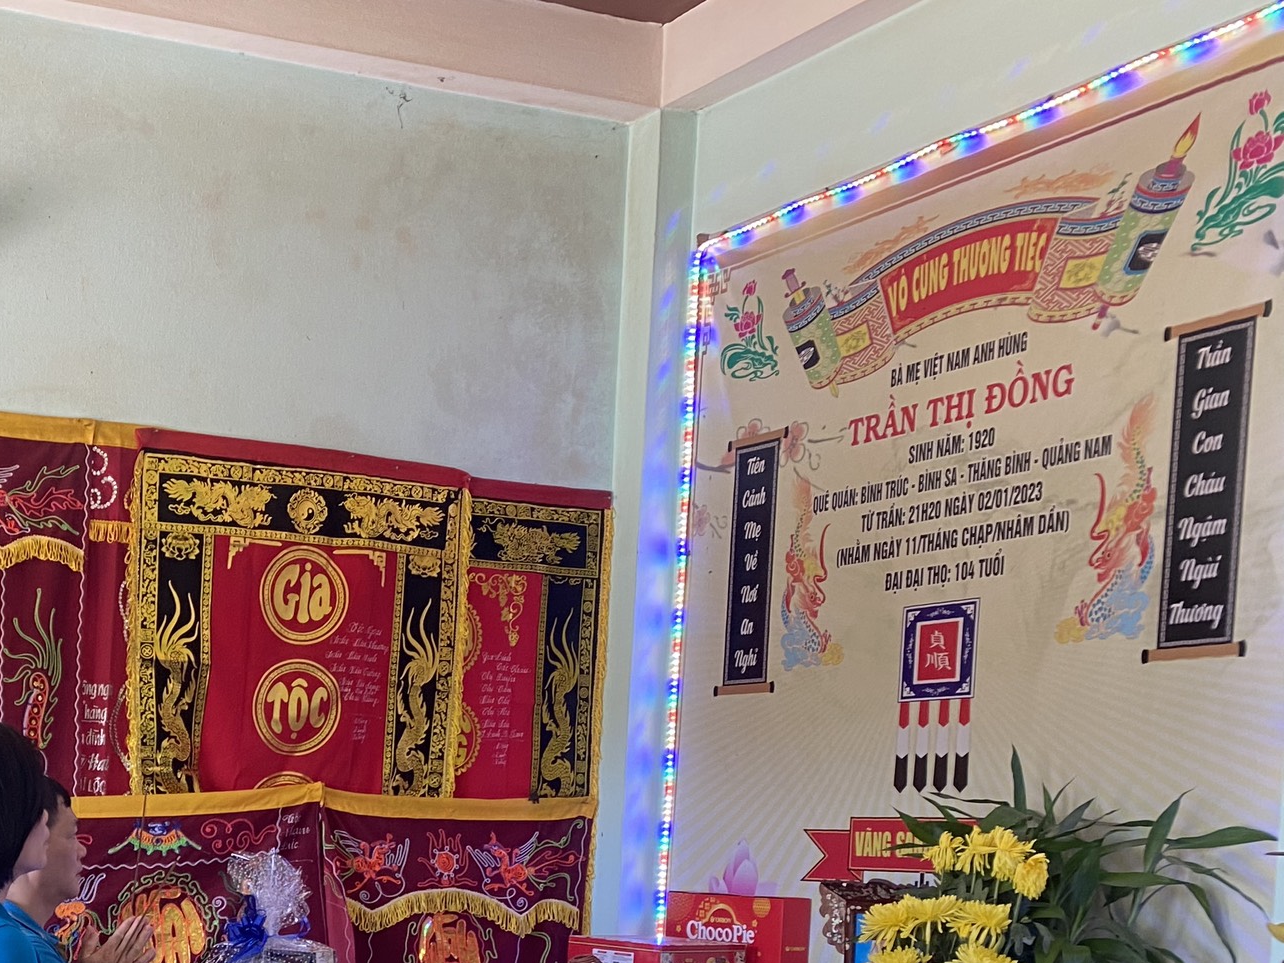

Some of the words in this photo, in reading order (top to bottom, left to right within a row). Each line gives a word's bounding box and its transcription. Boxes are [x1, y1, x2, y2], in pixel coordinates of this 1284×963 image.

[888, 269, 908, 317] VÔ
[912, 253, 949, 303] CÙNG
[890, 366, 903, 388] BÀ
[906, 361, 921, 386] MẸ
[923, 353, 944, 381] VIỆT
[946, 347, 971, 373] NAM
[972, 340, 995, 366] ANH
[997, 331, 1029, 358] HÙNG
[1196, 339, 1232, 370] Trần
[848, 394, 918, 447] TRẦN
[926, 388, 977, 429] THỊ
[984, 360, 1075, 415] ĐỒNG
[1190, 386, 1230, 420] Gian
[908, 441, 933, 464] SINH
[936, 433, 965, 458] NĂM:
[968, 427, 995, 451] 1920
[1191, 431, 1224, 454] Con
[746, 457, 766, 475] Tiên
[813, 490, 830, 515] QUÊ
[831, 486, 858, 511] QUÁN:
[860, 481, 883, 504] BÌNH
[885, 475, 909, 499] TRÚC
[918, 469, 942, 493] BÌNH
[944, 467, 957, 487] SA
[968, 457, 1001, 483] THĂNG
[1004, 450, 1032, 476] BÌNH
[1042, 438, 1081, 470] QUẢNG
[1084, 434, 1113, 460] NAM
[742, 488, 766, 508] Cảnh
[1183, 471, 1226, 498] Cháu
[861, 510, 875, 533] TỪ
[876, 502, 906, 531] TRẦN:
[908, 500, 941, 524] 21H20
[944, 491, 975, 518] NGÀY
[977, 481, 1043, 511] 02/01/2023
[743, 521, 762, 541] Mẹ
[873, 536, 902, 562] NGÀY
[905, 527, 958, 556] 11/THÁNG
[961, 514, 1035, 549] CHẠP/NHÂM
[744, 550, 759, 572] Về
[885, 570, 902, 594] ĐẠI
[905, 567, 924, 592] ĐẠI
[927, 564, 951, 588] THỌ:
[955, 561, 975, 582] 104
[979, 548, 1004, 578] TUỔI
[1179, 554, 1222, 589] Ngùi
[273, 562, 333, 624] Gia
[740, 584, 759, 604] Nơi
[740, 617, 754, 636] An
[1168, 601, 1225, 629] Thương
[267, 678, 328, 740] TỘC
[855, 828, 892, 857] VÃNG
[686, 920, 755, 945] ChocoPie
